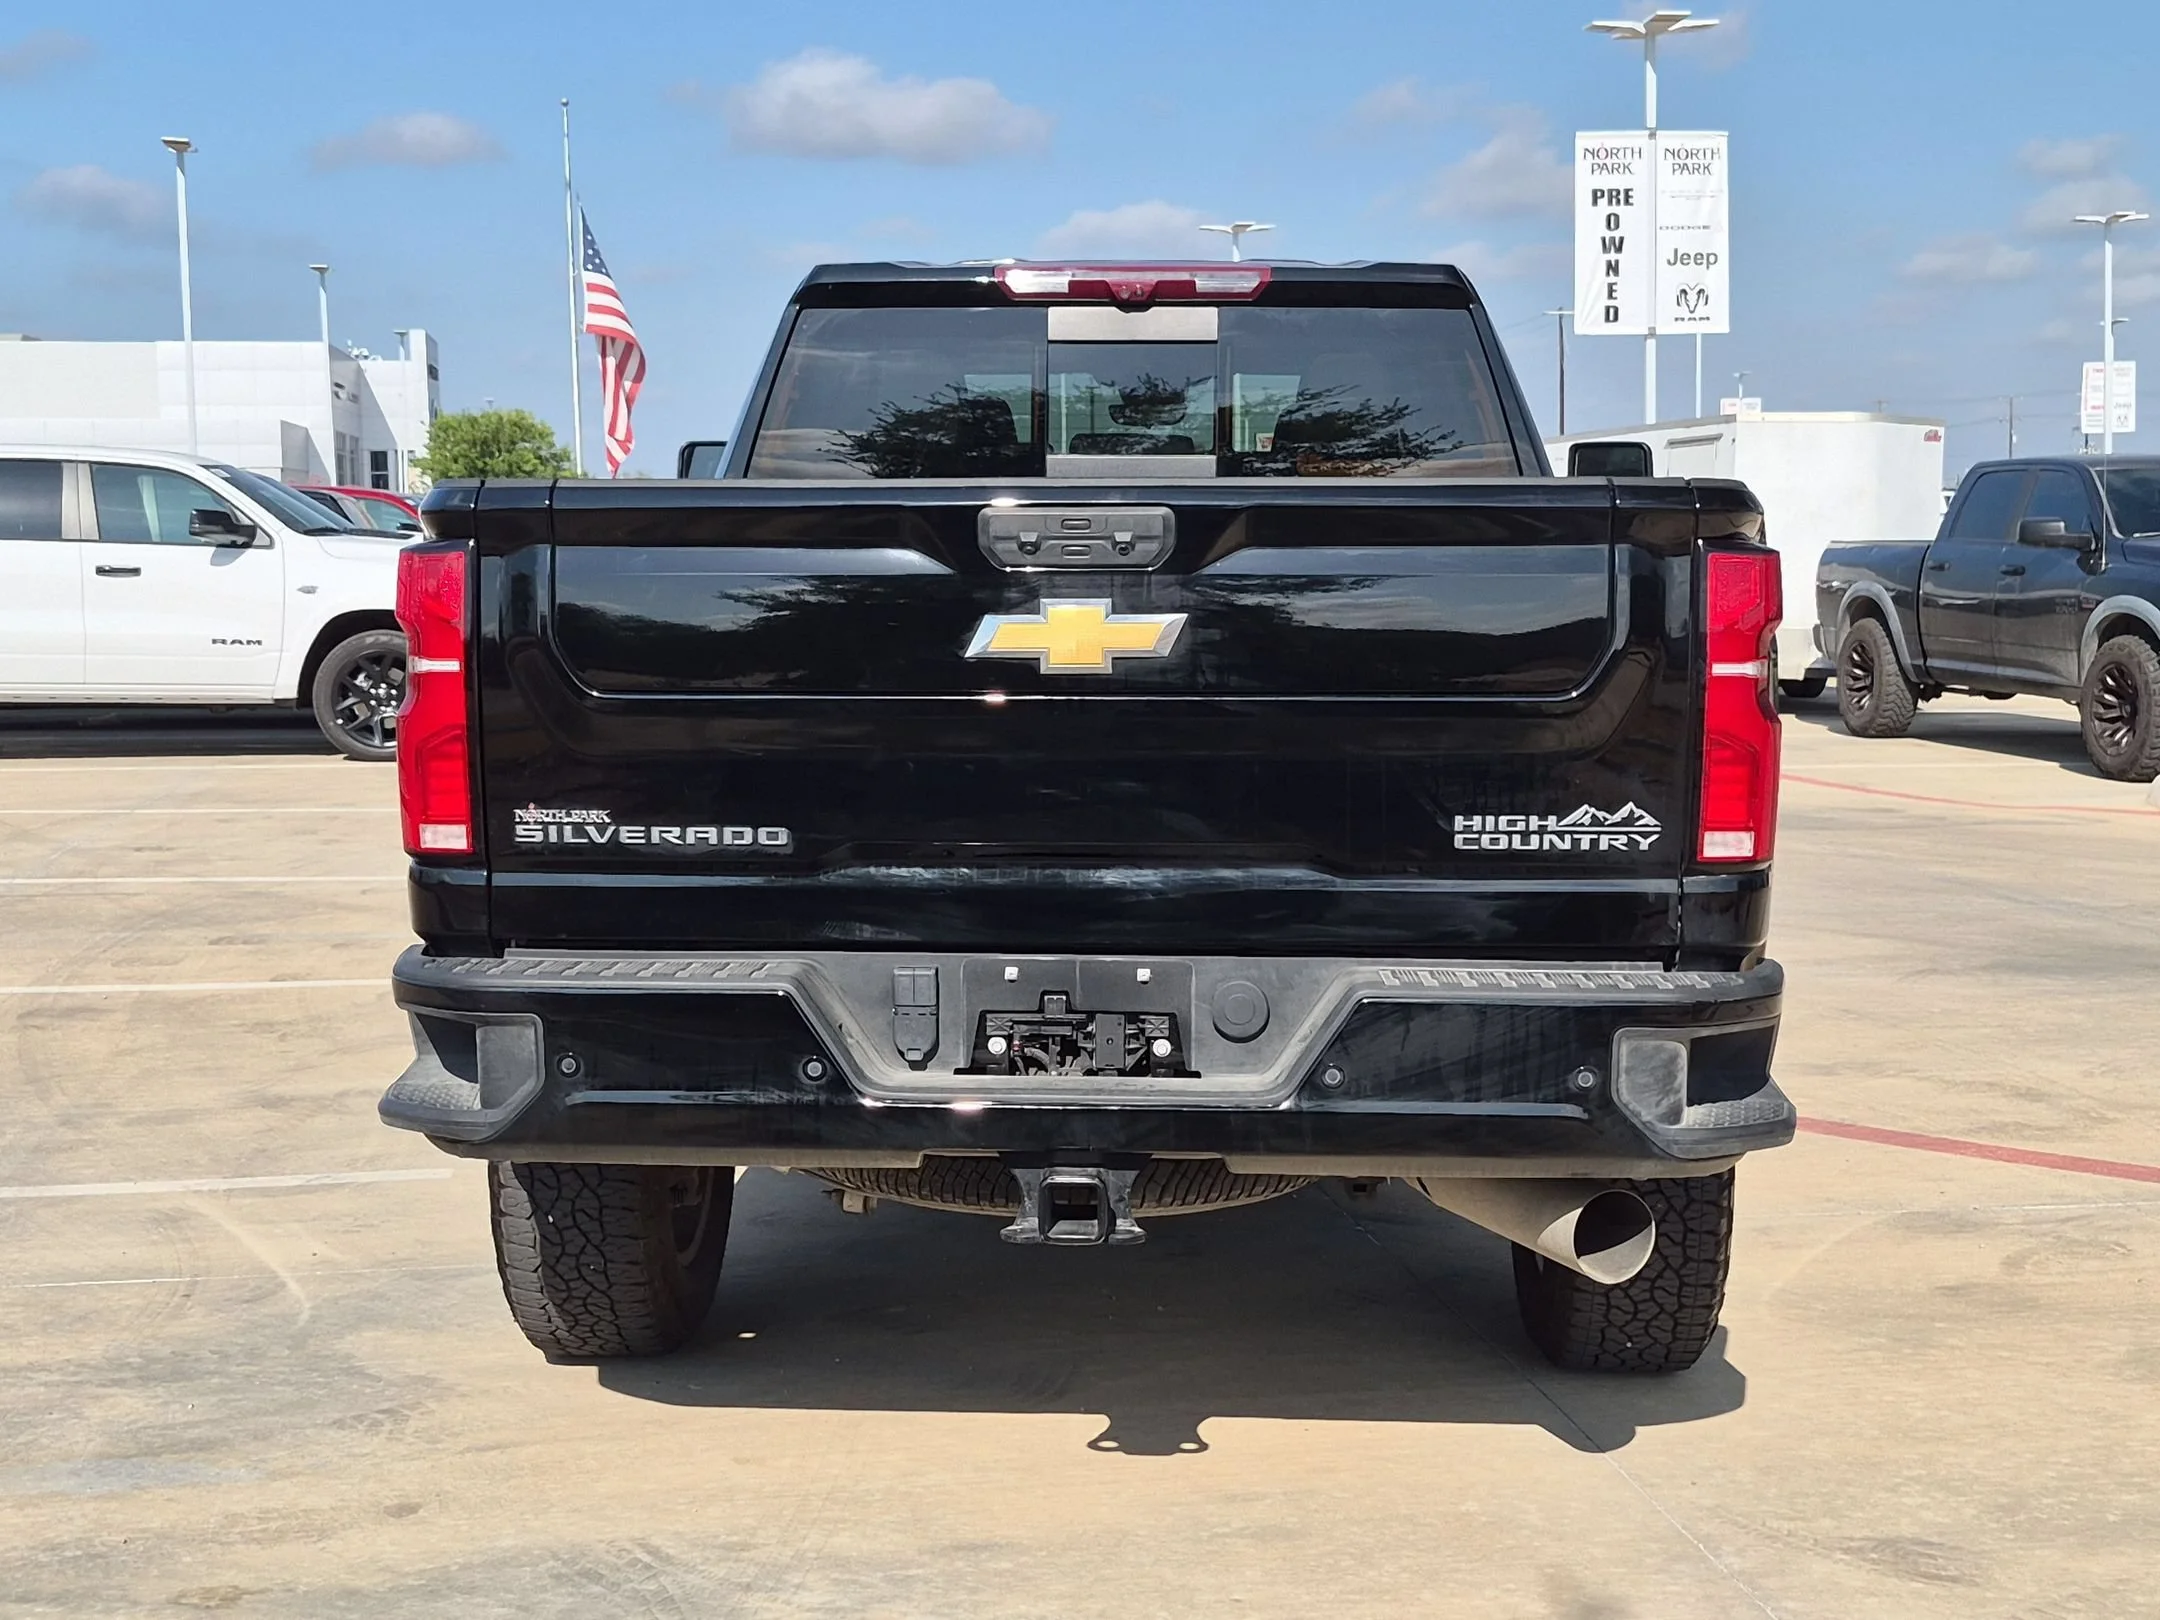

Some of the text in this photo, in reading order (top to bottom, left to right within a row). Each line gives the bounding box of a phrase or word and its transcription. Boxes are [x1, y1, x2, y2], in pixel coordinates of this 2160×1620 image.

[1583, 145, 1642, 160] NORTH
[1664, 146, 1721, 161] NORTH
[1591, 162, 1634, 176] PARK
[1672, 162, 1712, 176] PARK
[1591, 188, 1634, 207] PRE
[1666, 248, 1719, 270] Jeep
[211, 638, 263, 646] RAM
[568, 809, 611, 823] PARK
[1454, 815, 1558, 831] HIGH
[514, 824, 790, 845] SILVERADO
[1453, 833, 1661, 850] COUNTRY
